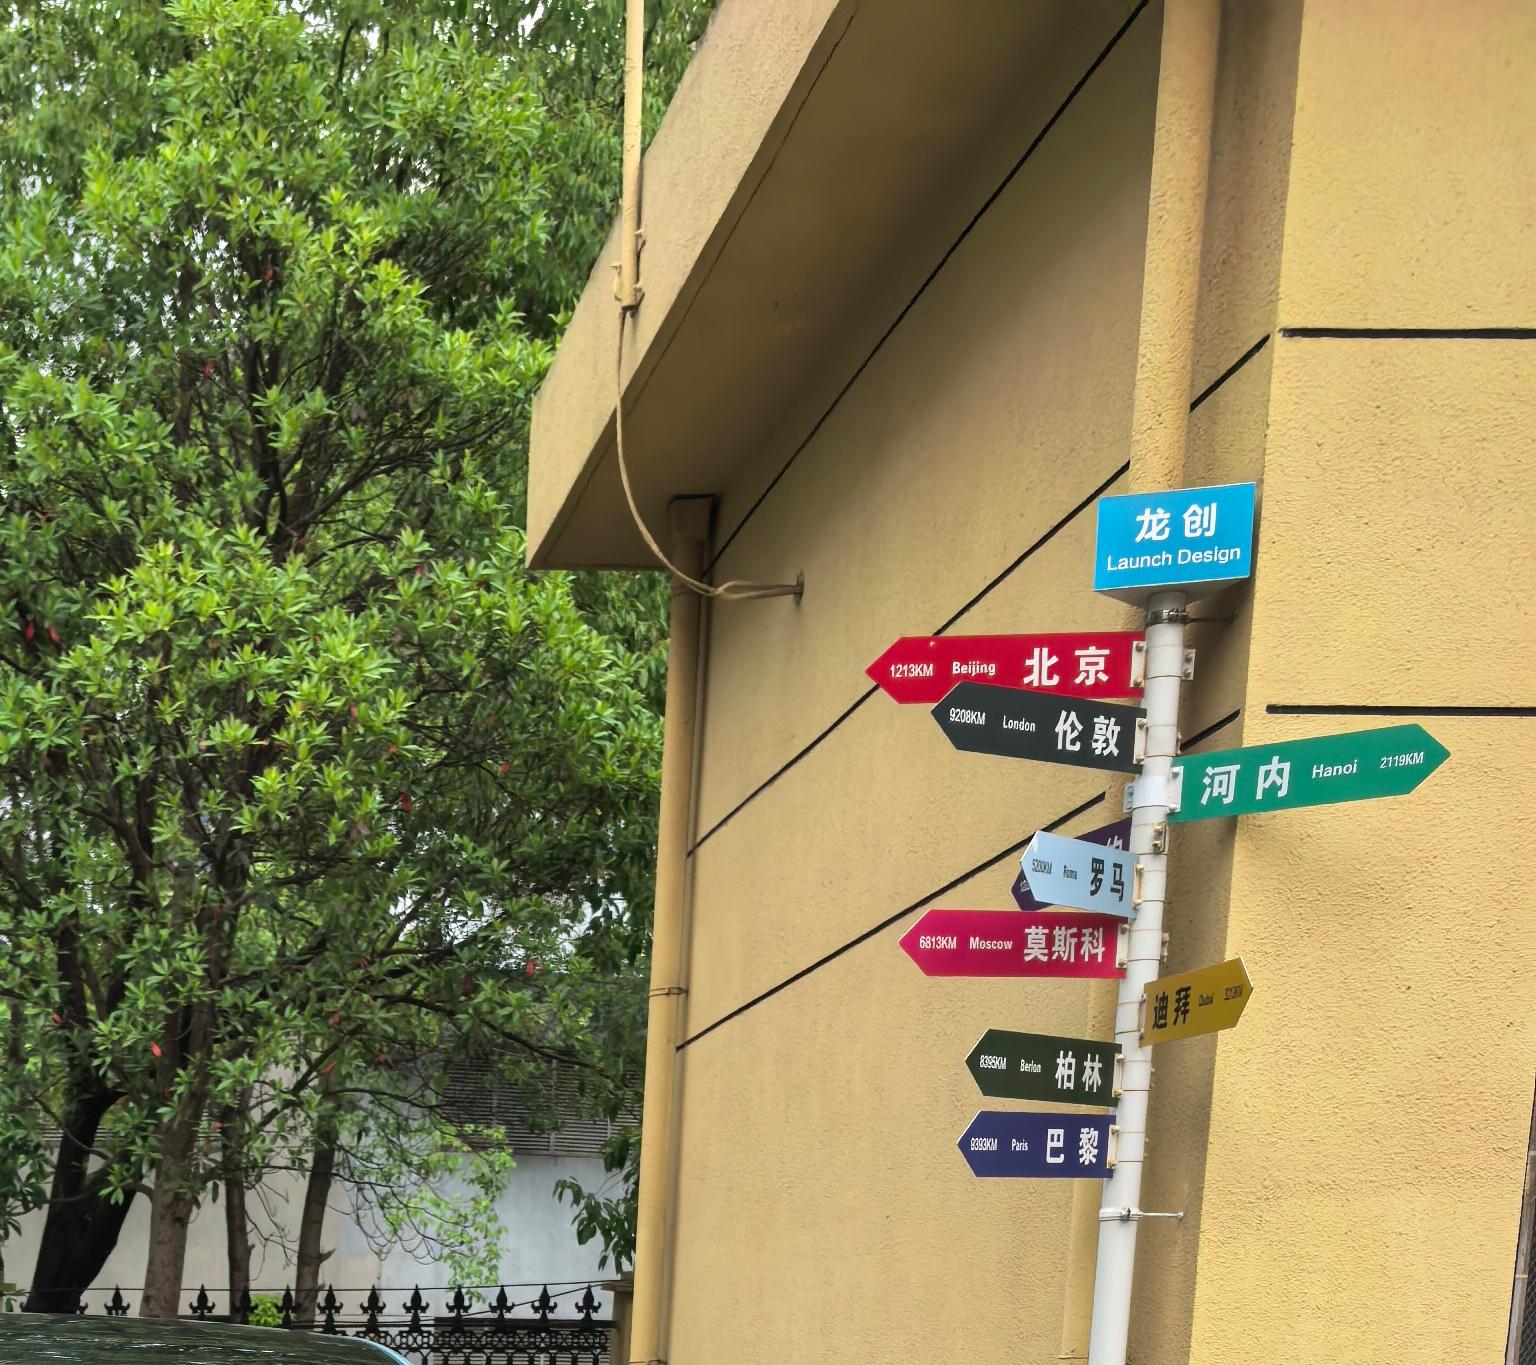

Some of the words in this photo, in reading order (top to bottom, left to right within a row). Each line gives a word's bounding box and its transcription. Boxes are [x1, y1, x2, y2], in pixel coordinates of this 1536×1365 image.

[1135, 502, 1217, 543] 龙创
[1107, 551, 1172, 571] Launch
[1178, 546, 1241, 565] Design
[890, 663, 934, 678] 1213KM
[952, 660, 996, 676] Beijing
[1023, 646, 1110, 687] 北京
[949, 707, 986, 725] 9208KM
[1003, 715, 1036, 733] London
[1055, 710, 1121, 757] 伦敦
[1201, 755, 1291, 805] 河内
[1312, 758, 1358, 778] Hanoi
[1380, 751, 1425, 769] 2119KM
[1090, 857, 1124, 902] 罗马
[919, 935, 957, 950] 6813KM
[969, 936, 1013, 950] Moscow
[1024, 925, 1106, 963] 莫斯科
[1152, 986, 1191, 1030] 迪拜
[1055, 1050, 1102, 1093] 柏林
[1011, 1138, 1028, 1151] Paris
[1046, 1128, 1099, 1166] 巴黎
